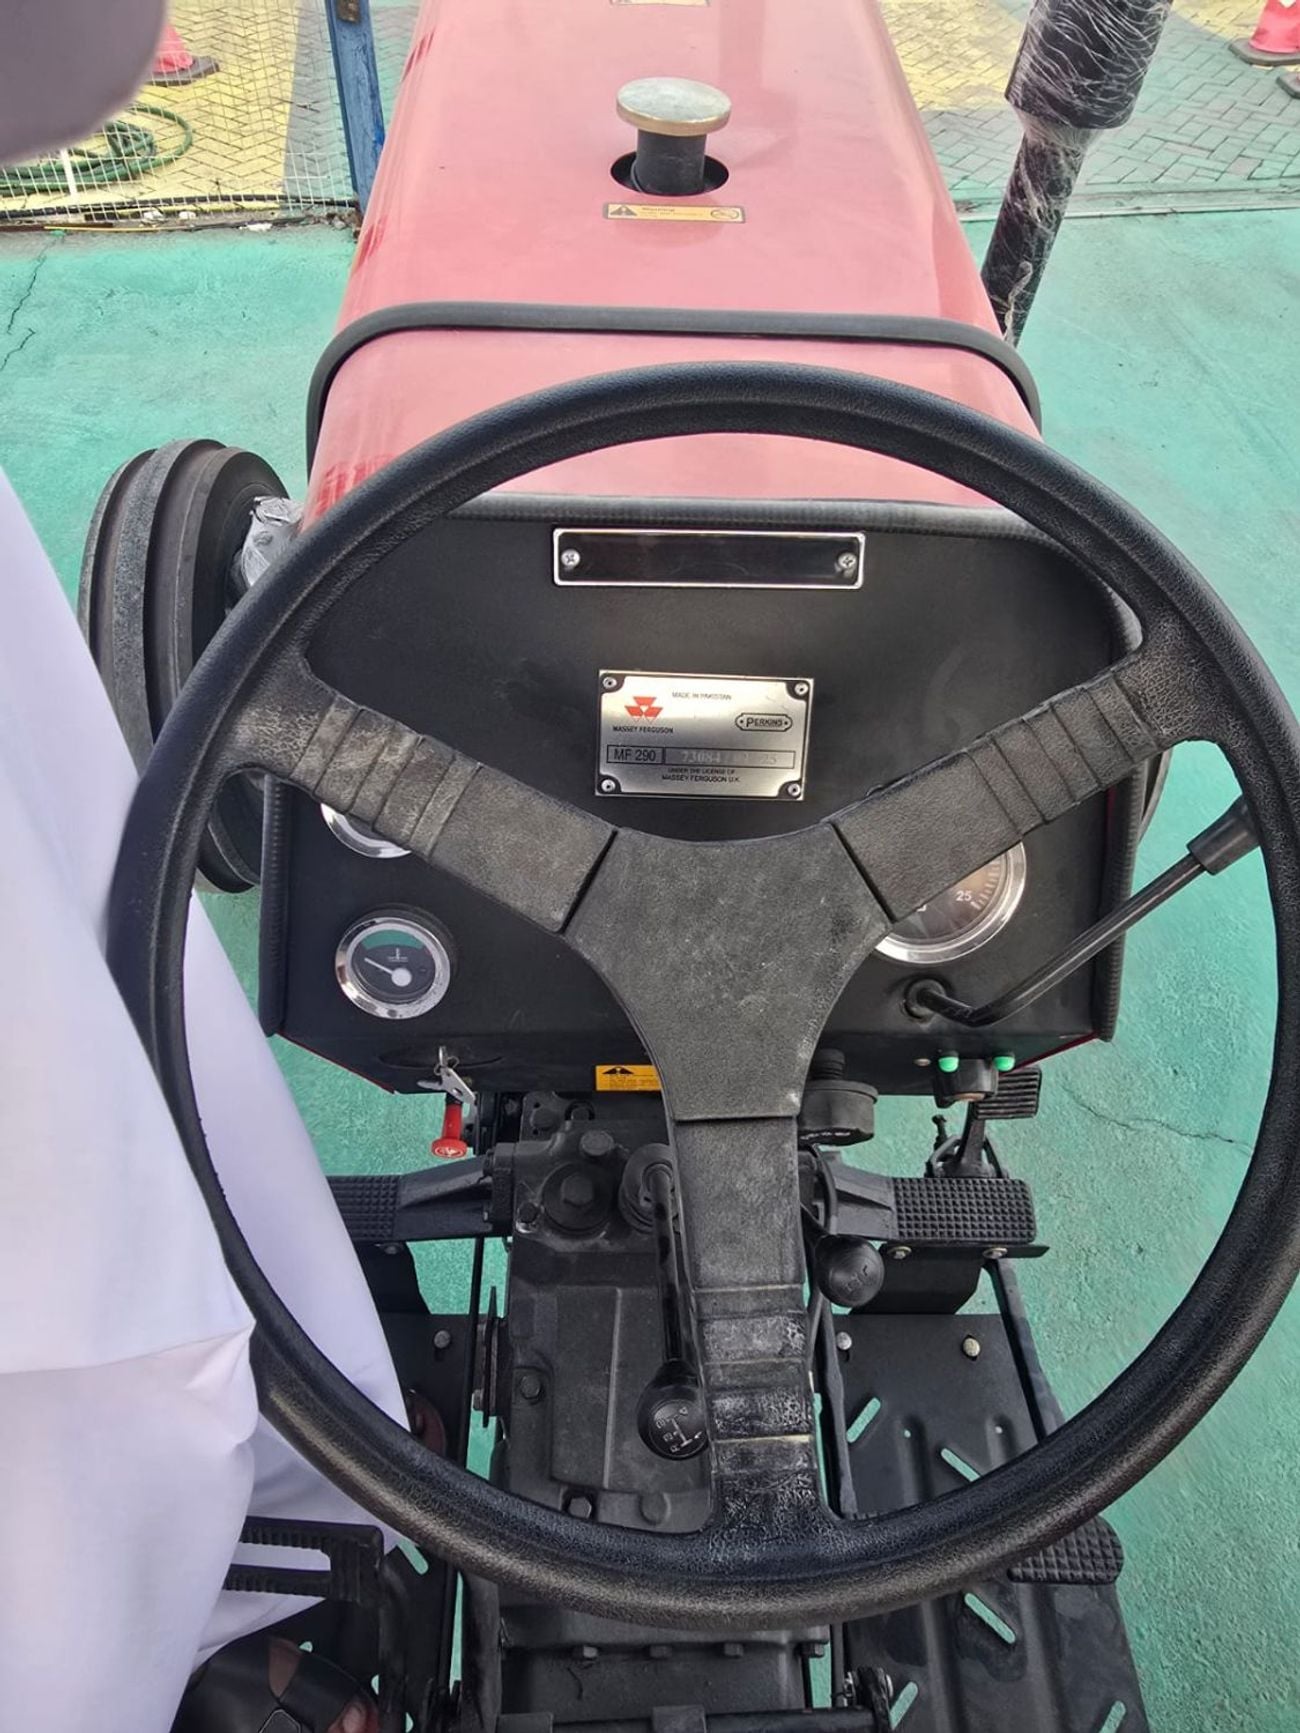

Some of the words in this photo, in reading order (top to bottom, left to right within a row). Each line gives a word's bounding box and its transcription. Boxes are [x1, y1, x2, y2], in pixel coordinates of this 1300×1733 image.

[746, 717, 783, 728] PERKINS
[613, 725, 638, 733] MASSEY
[640, 726, 674, 734] FERGUSON
[614, 748, 632, 760] MF
[635, 749, 656, 761] 290
[689, 775, 727, 783] FERGUSON
[955, 890, 972, 902] 25
